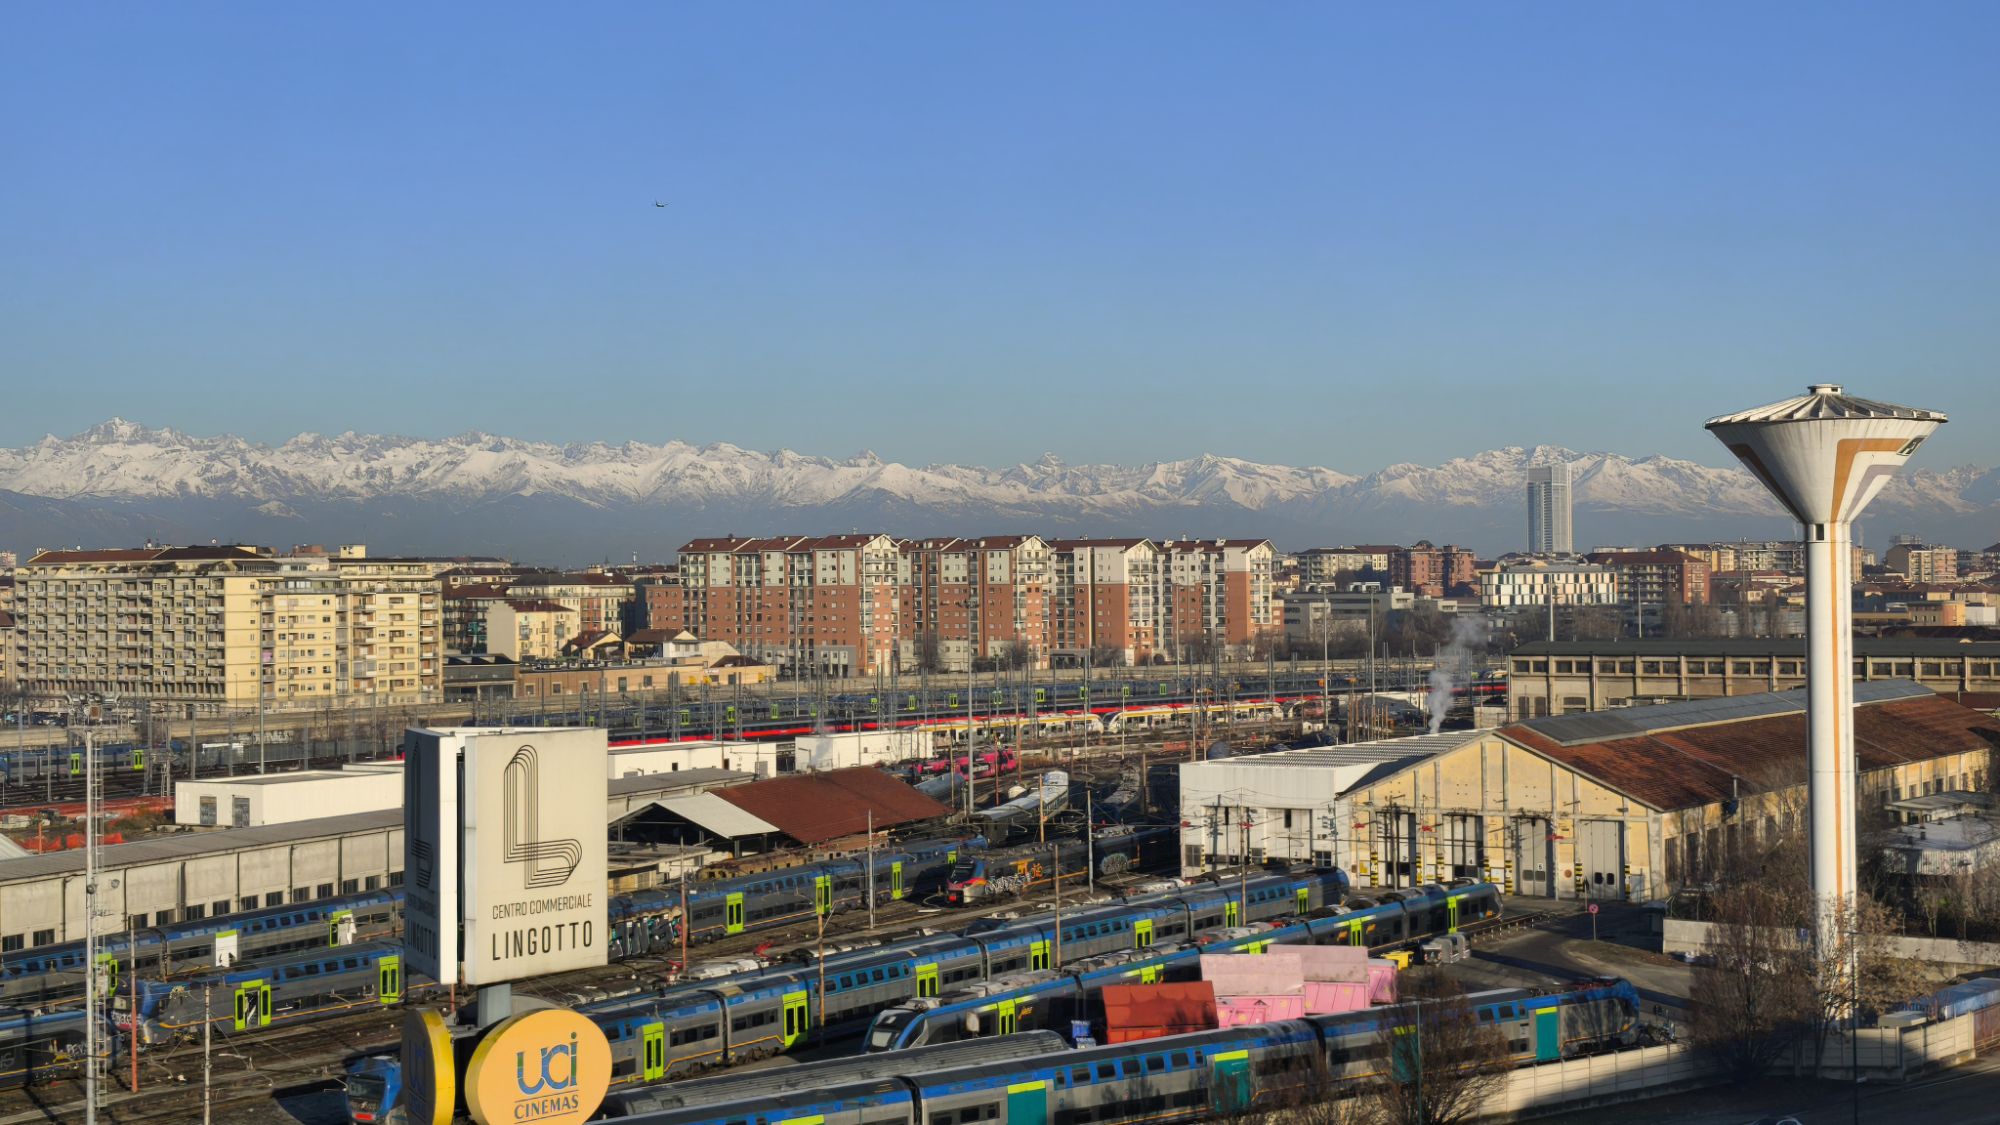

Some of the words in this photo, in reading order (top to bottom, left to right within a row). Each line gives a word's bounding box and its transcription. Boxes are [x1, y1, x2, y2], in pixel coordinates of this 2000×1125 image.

[492, 901, 527, 920] CENTRO
[529, 893, 592, 915] COMMERCIALE
[492, 920, 592, 961] LINGOTTO
[514, 1094, 579, 1120] CINEMAS
